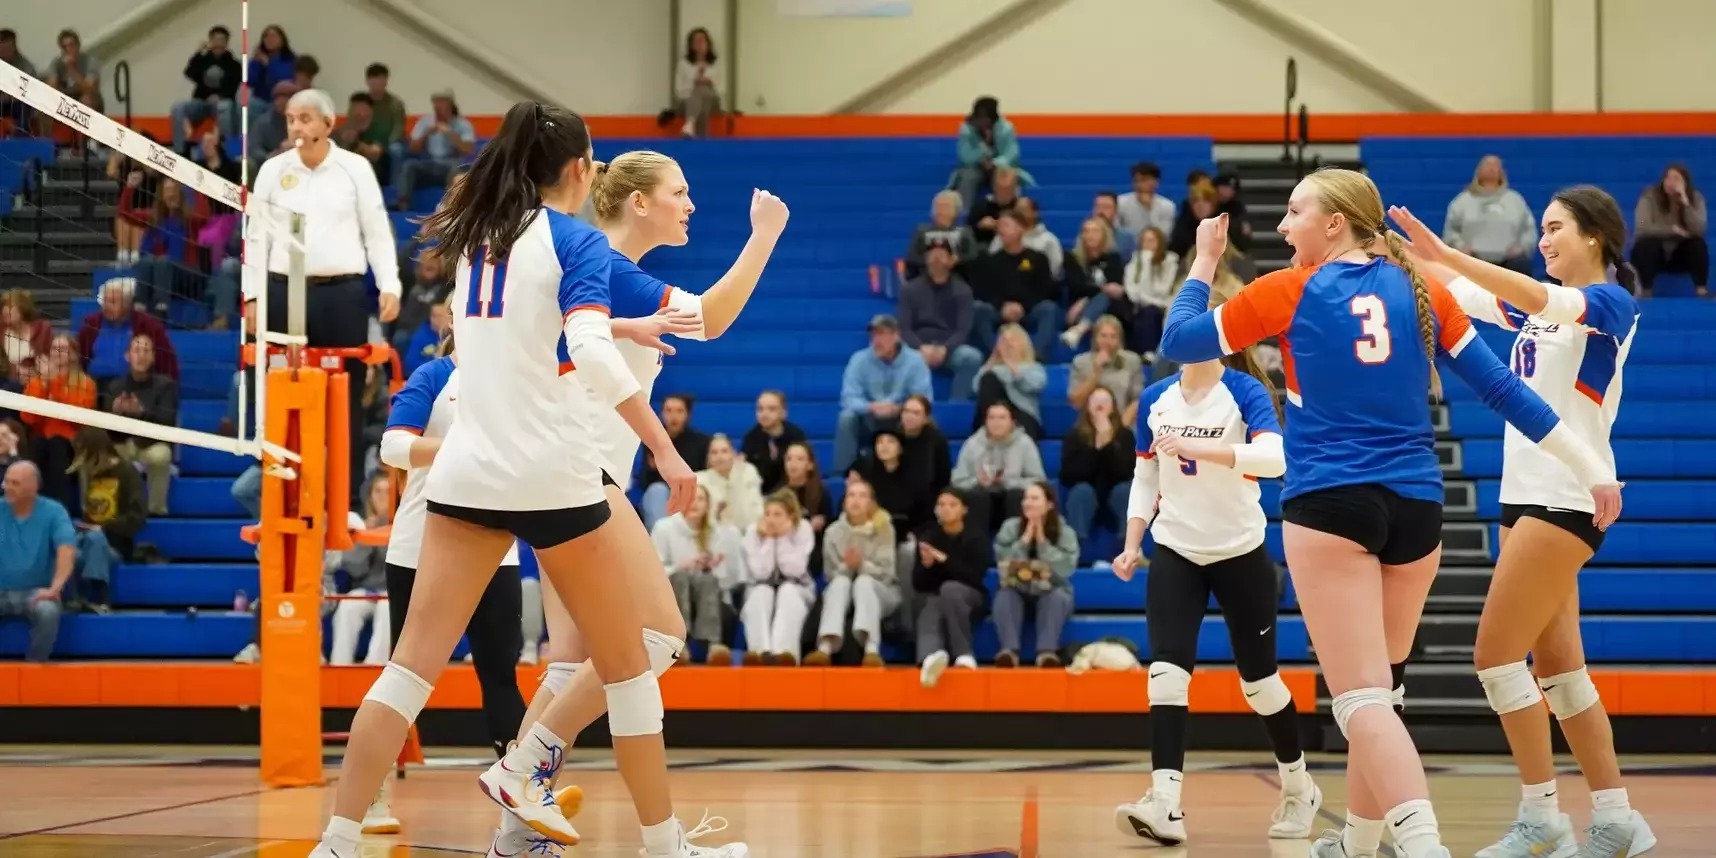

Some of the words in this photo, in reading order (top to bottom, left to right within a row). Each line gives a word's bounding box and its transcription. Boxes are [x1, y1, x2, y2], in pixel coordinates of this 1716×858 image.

[466, 243, 512, 318] 11
[1350, 292, 1392, 366] 3
[1514, 337, 1536, 378] 18
